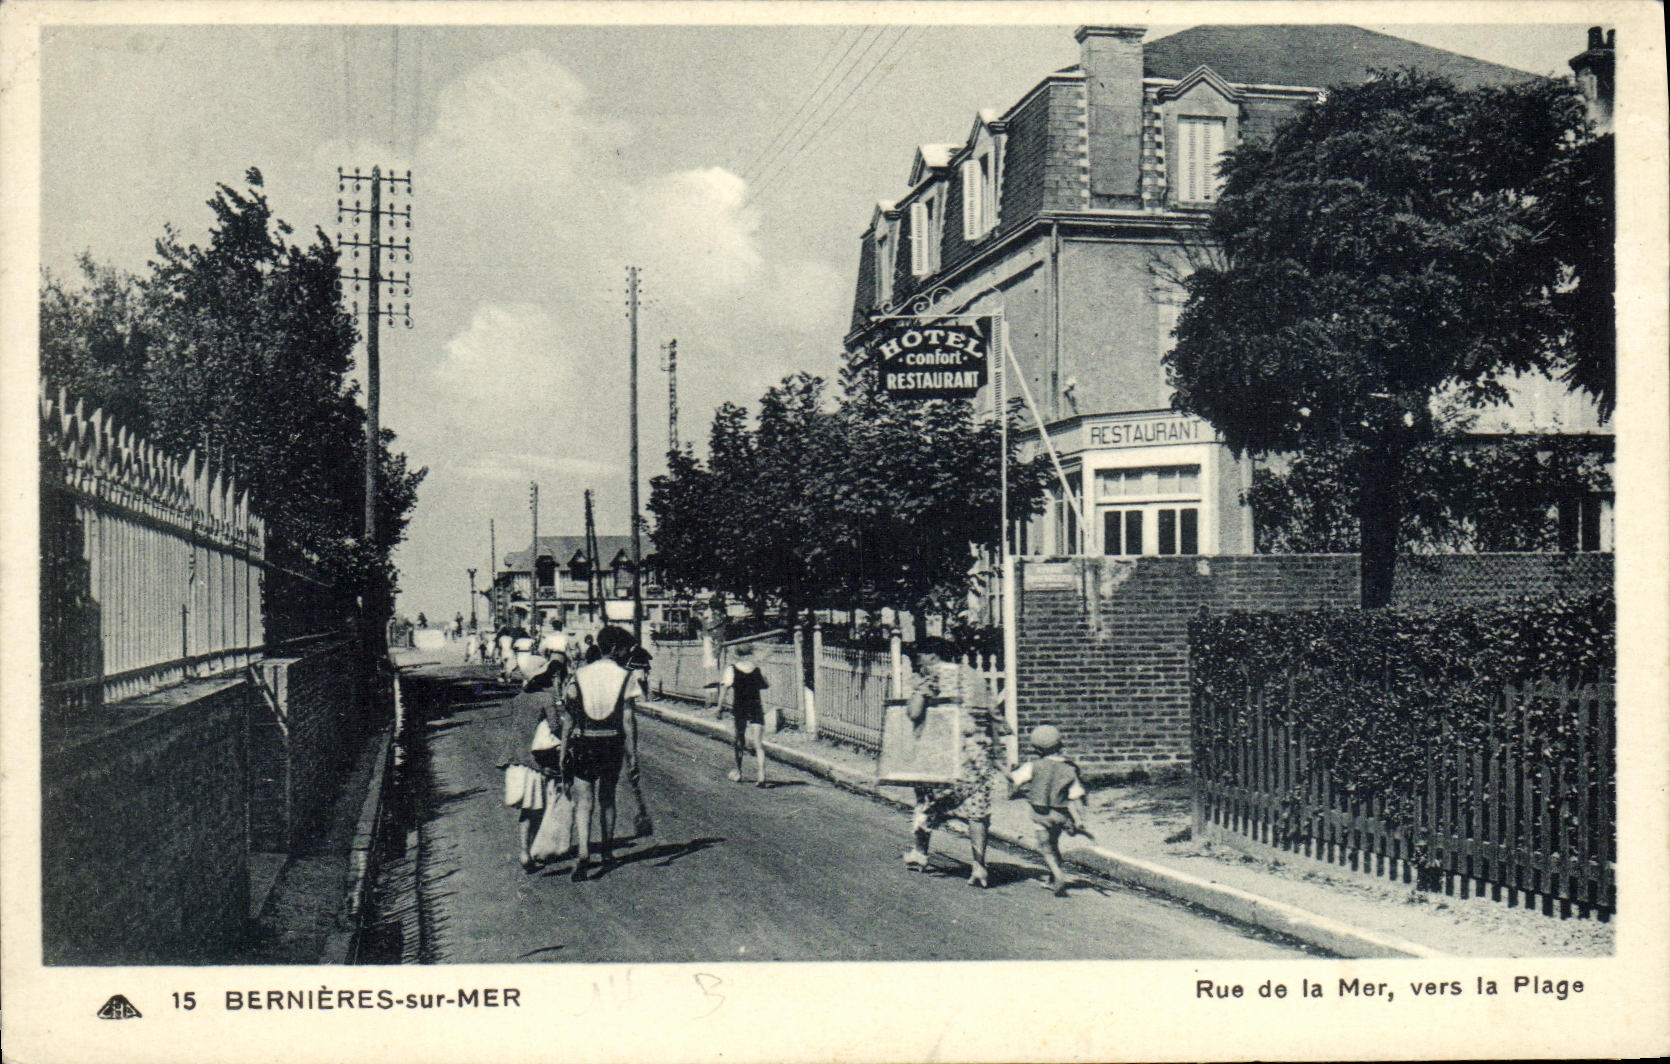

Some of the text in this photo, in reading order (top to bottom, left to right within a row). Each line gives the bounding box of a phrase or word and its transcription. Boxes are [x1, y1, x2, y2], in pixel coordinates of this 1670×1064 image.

[906, 348, 962, 365] confort
[886, 371, 979, 390] RESTAURANT
[1091, 420, 1201, 445] RESTAURANT
